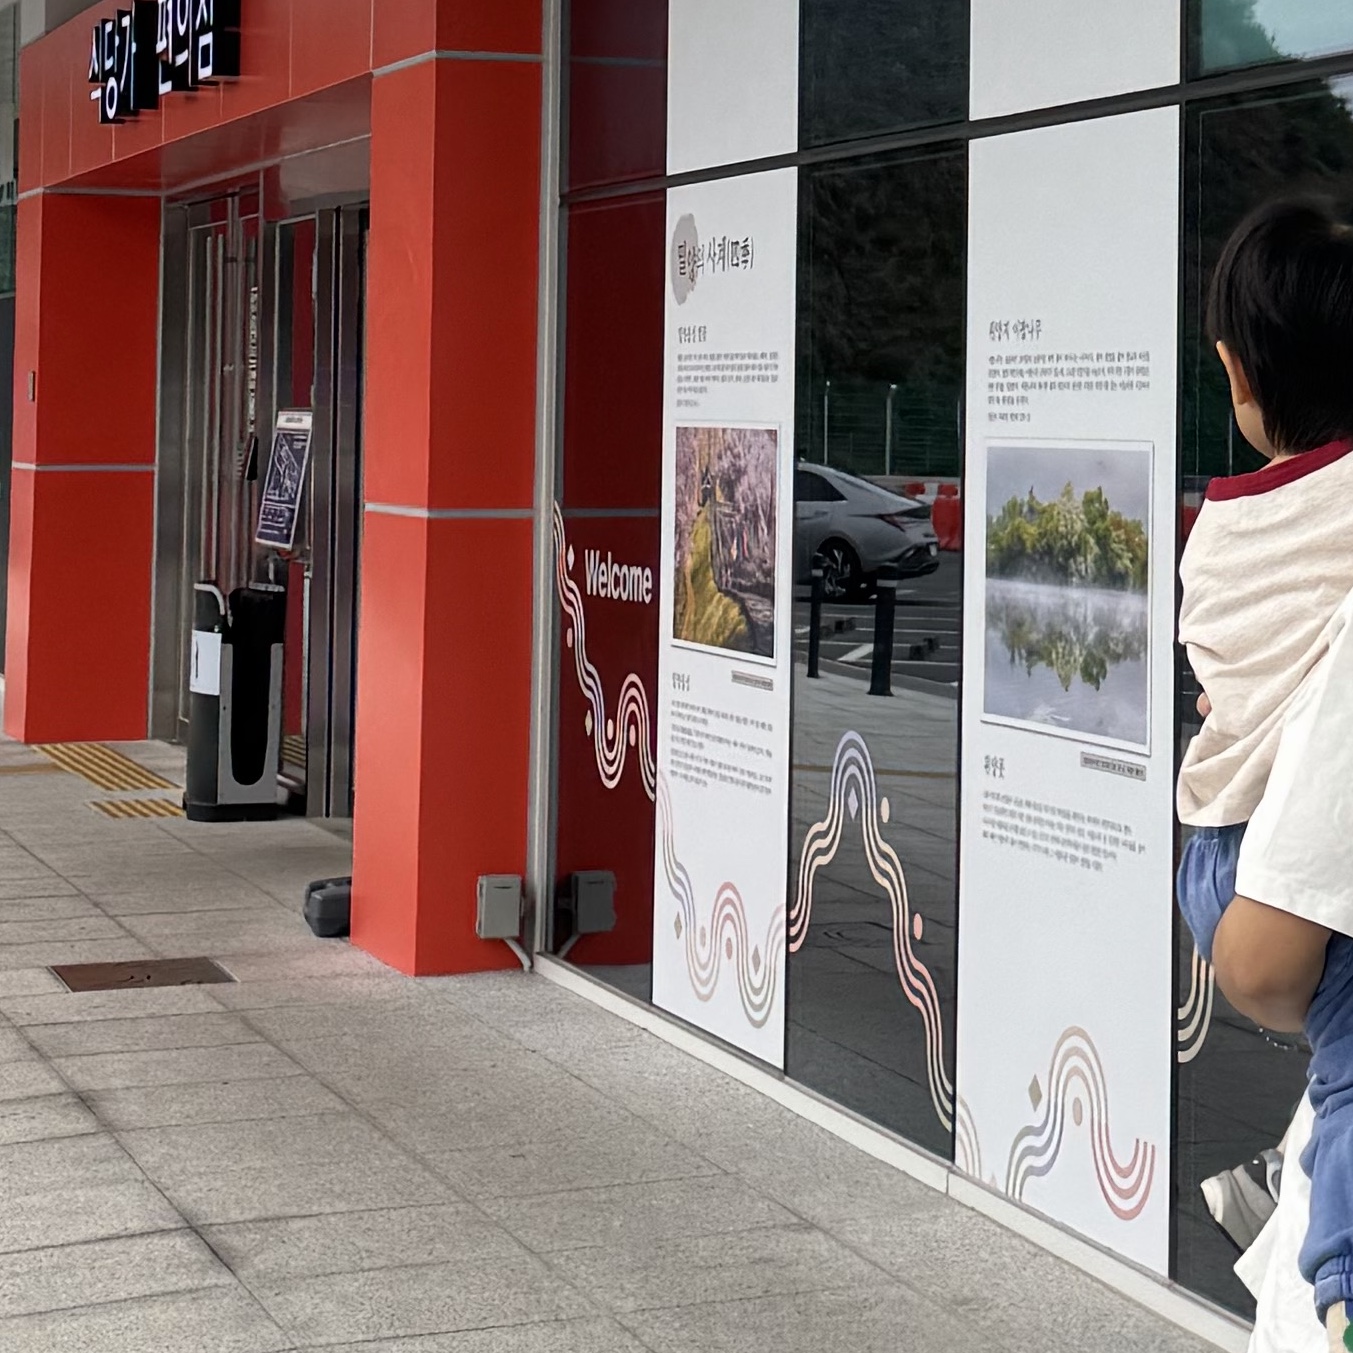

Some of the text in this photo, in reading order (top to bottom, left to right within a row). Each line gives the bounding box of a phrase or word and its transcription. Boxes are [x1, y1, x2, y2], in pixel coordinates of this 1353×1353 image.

[88, 0, 214, 120] 식당가 편의점
[584, 549, 653, 604] Welcome
